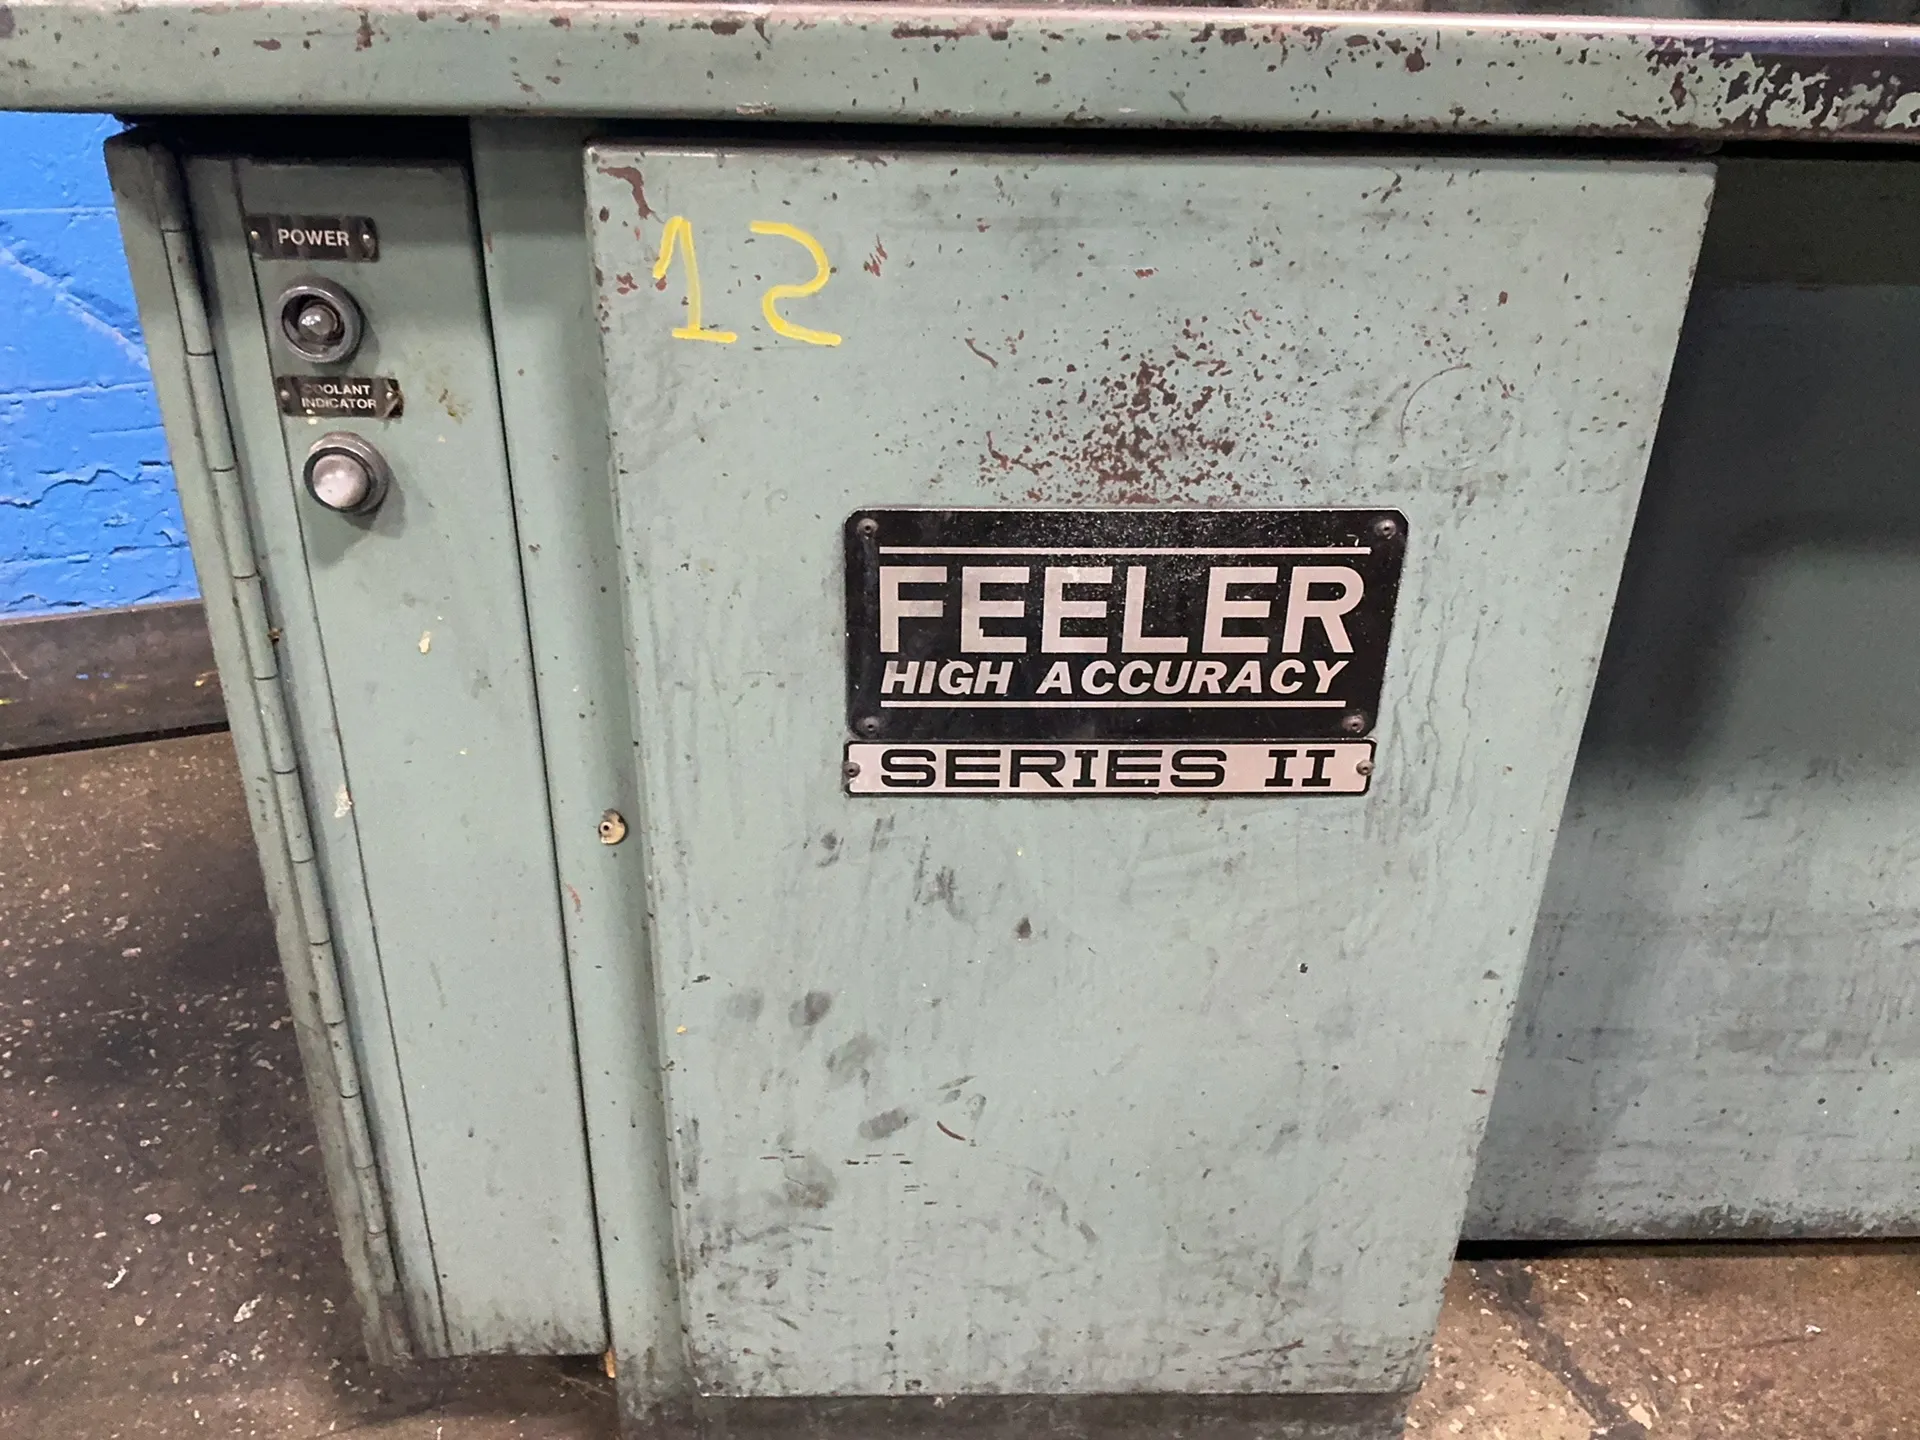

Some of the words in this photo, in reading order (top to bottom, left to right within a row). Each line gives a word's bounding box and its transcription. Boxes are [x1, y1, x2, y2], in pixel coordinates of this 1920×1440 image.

[277, 228, 350, 247] POWER
[652, 215, 842, 346] 12
[301, 397, 377, 410] INDICATOR
[879, 566, 1364, 653] FEELER
[880, 661, 1013, 694] HIGH
[1036, 660, 1349, 694] ACCURACY
[880, 749, 1226, 788] SERIES
[1263, 750, 1336, 788] II
